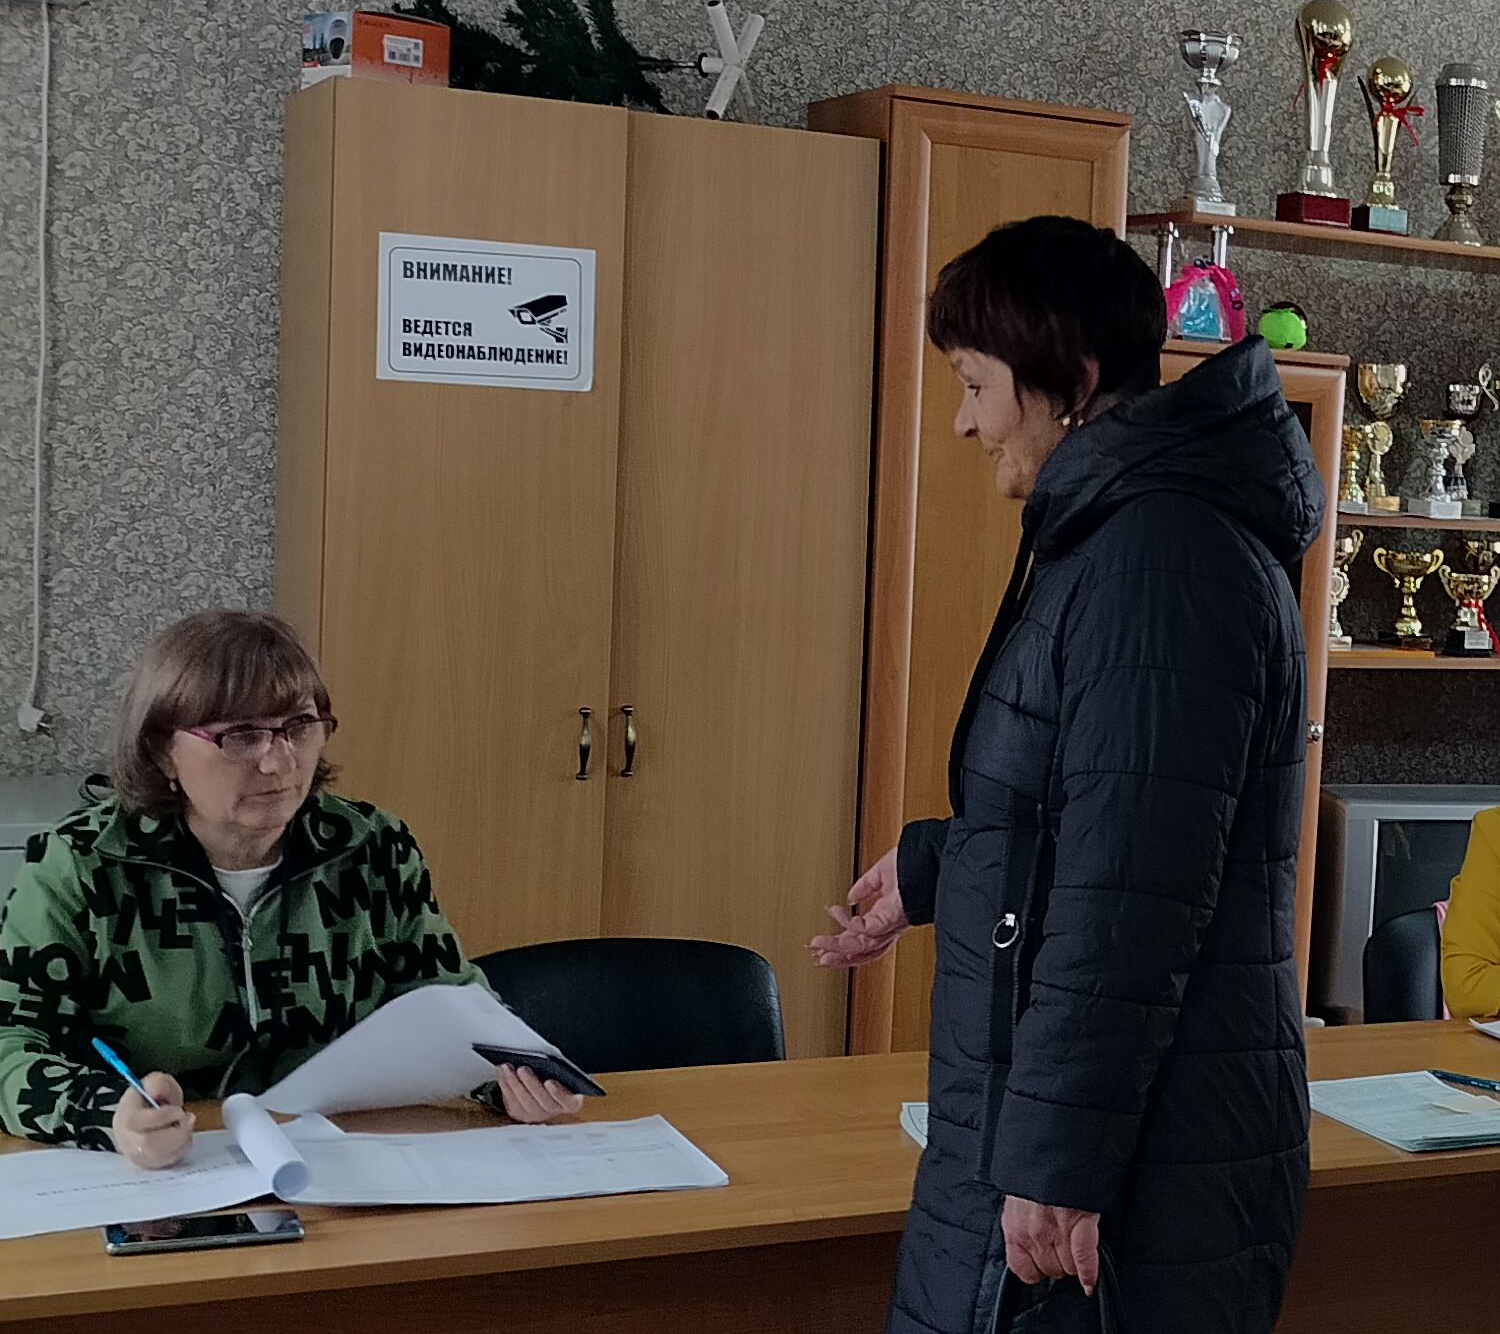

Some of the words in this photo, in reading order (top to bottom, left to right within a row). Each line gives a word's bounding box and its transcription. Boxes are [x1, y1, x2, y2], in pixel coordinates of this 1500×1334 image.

[402, 260, 512, 286] ВНИМАНИЕ!
[402, 318, 473, 338] ВЕДЕТСЯ
[402, 341, 568, 366] ВИДЕОНАБЛЮДЕНИЕ!
